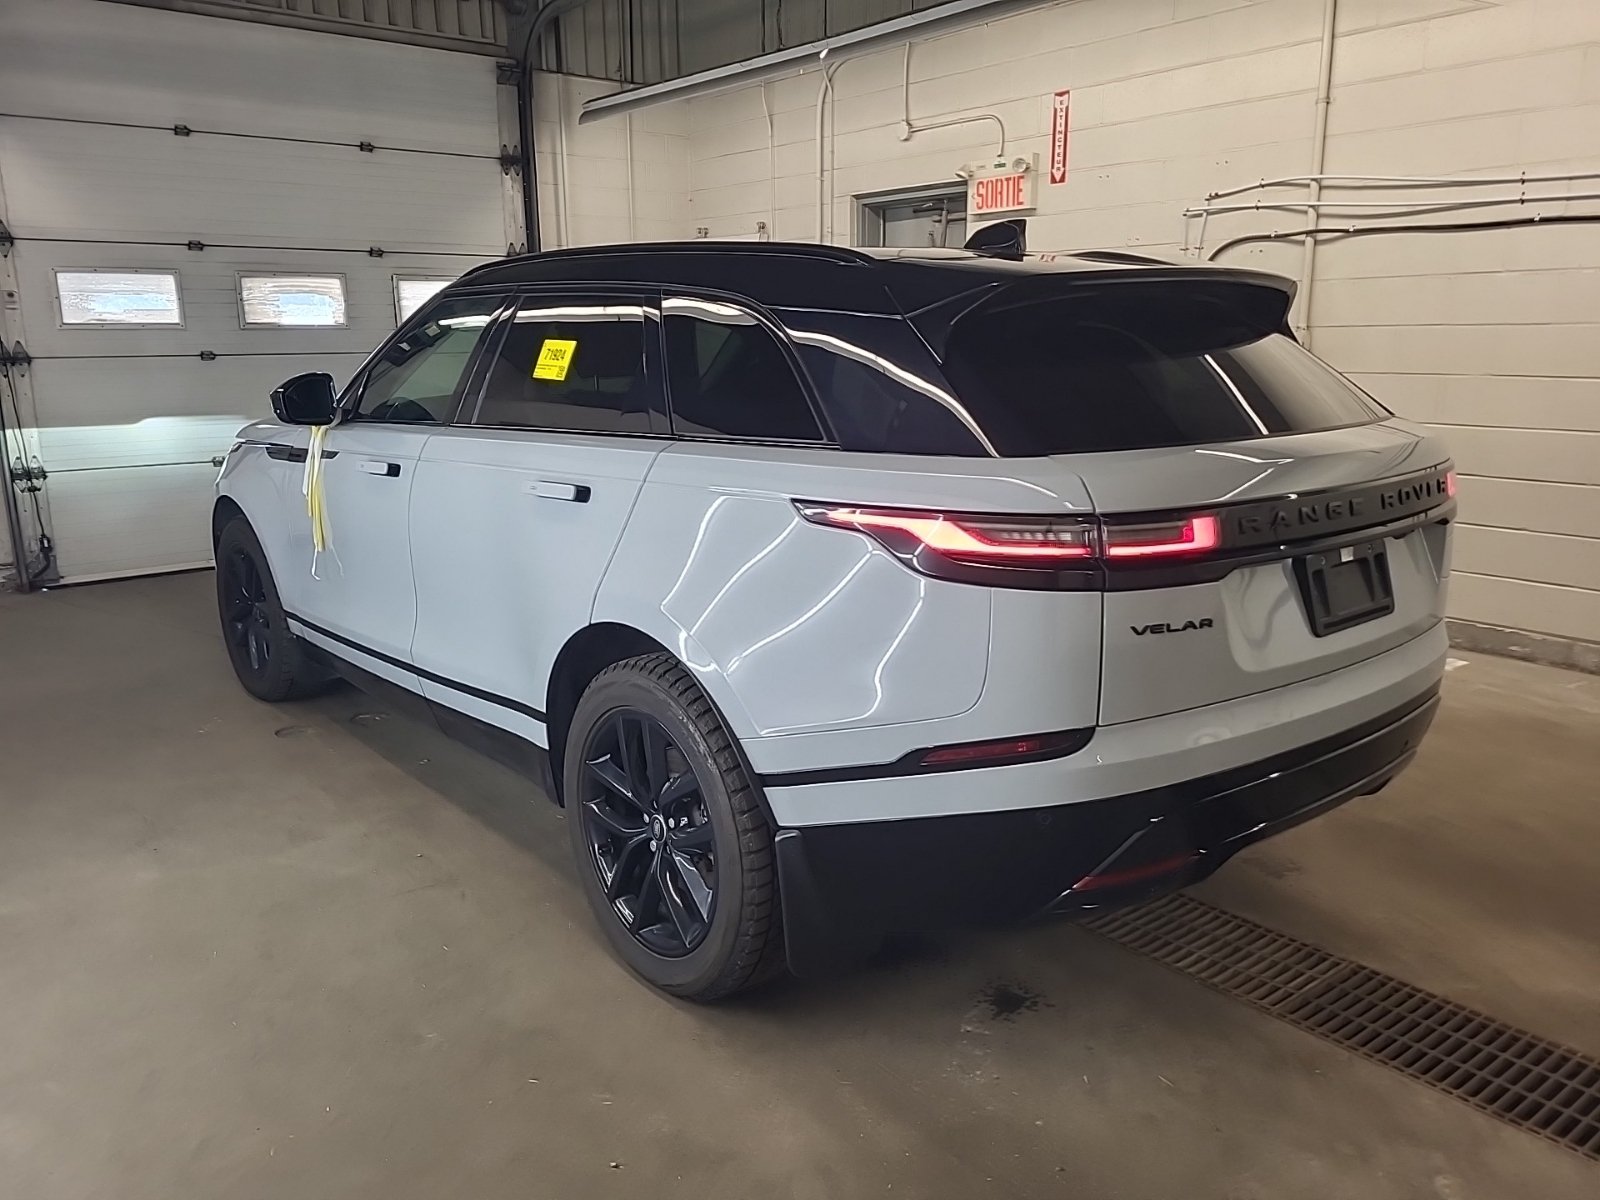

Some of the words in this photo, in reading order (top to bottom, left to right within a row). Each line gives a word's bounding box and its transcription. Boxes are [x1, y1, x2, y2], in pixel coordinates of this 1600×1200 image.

[1056, 99, 1065, 172] EXTINCTEUR
[976, 175, 1025, 209] SORTIE
[1237, 497, 1363, 535] RANGE
[1129, 618, 1213, 635] VELAR
